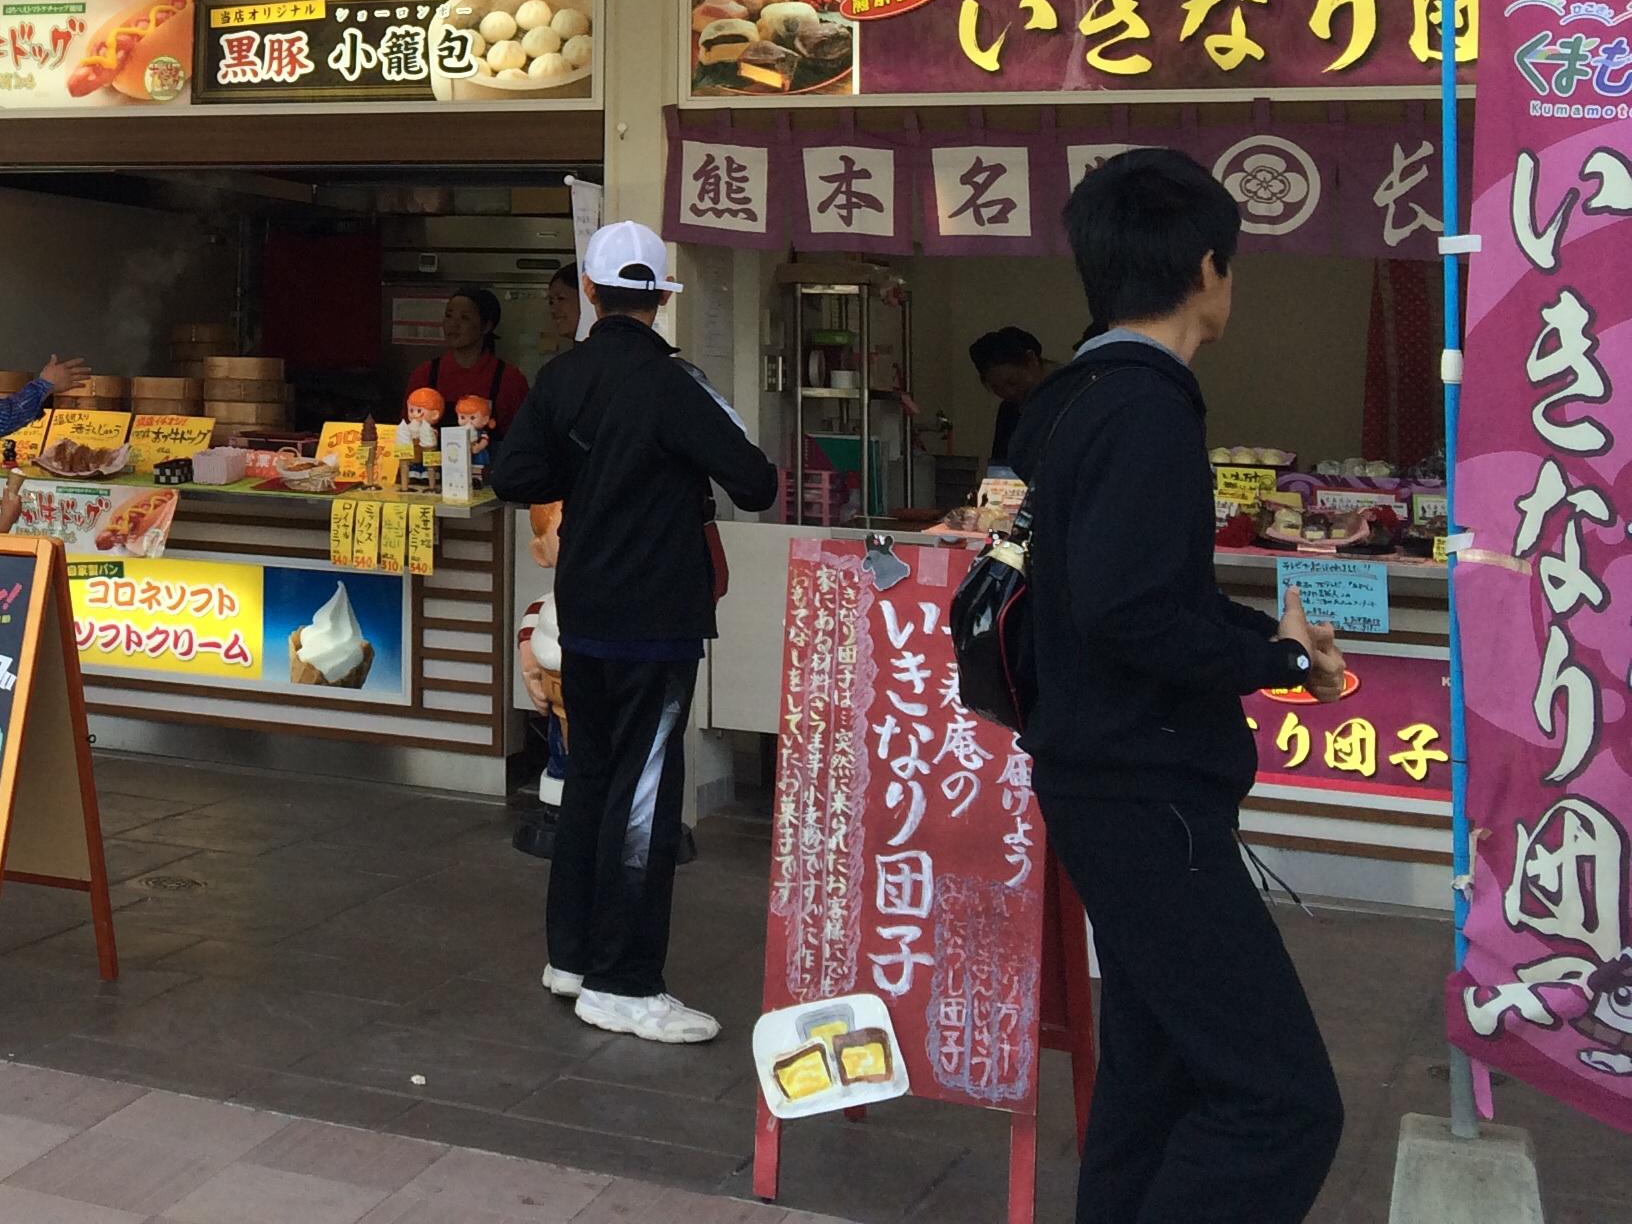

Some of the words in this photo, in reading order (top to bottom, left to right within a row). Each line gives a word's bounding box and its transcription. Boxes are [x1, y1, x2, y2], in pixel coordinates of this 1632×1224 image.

[220, 5, 316, 24] 当店オリジナル
[218, 30, 314, 83] 黒豚
[328, 26, 478, 81] 小籠包
[1530, 100, 1632, 119] Kumamot
[689, 143, 1136, 226] 熊本名
[87, 579, 238, 618] コロネソフト
[74, 620, 252, 665] ソフトクリーム
[1247, 712, 1449, 781] り団子
[872, 600, 940, 996] いきなり団子
